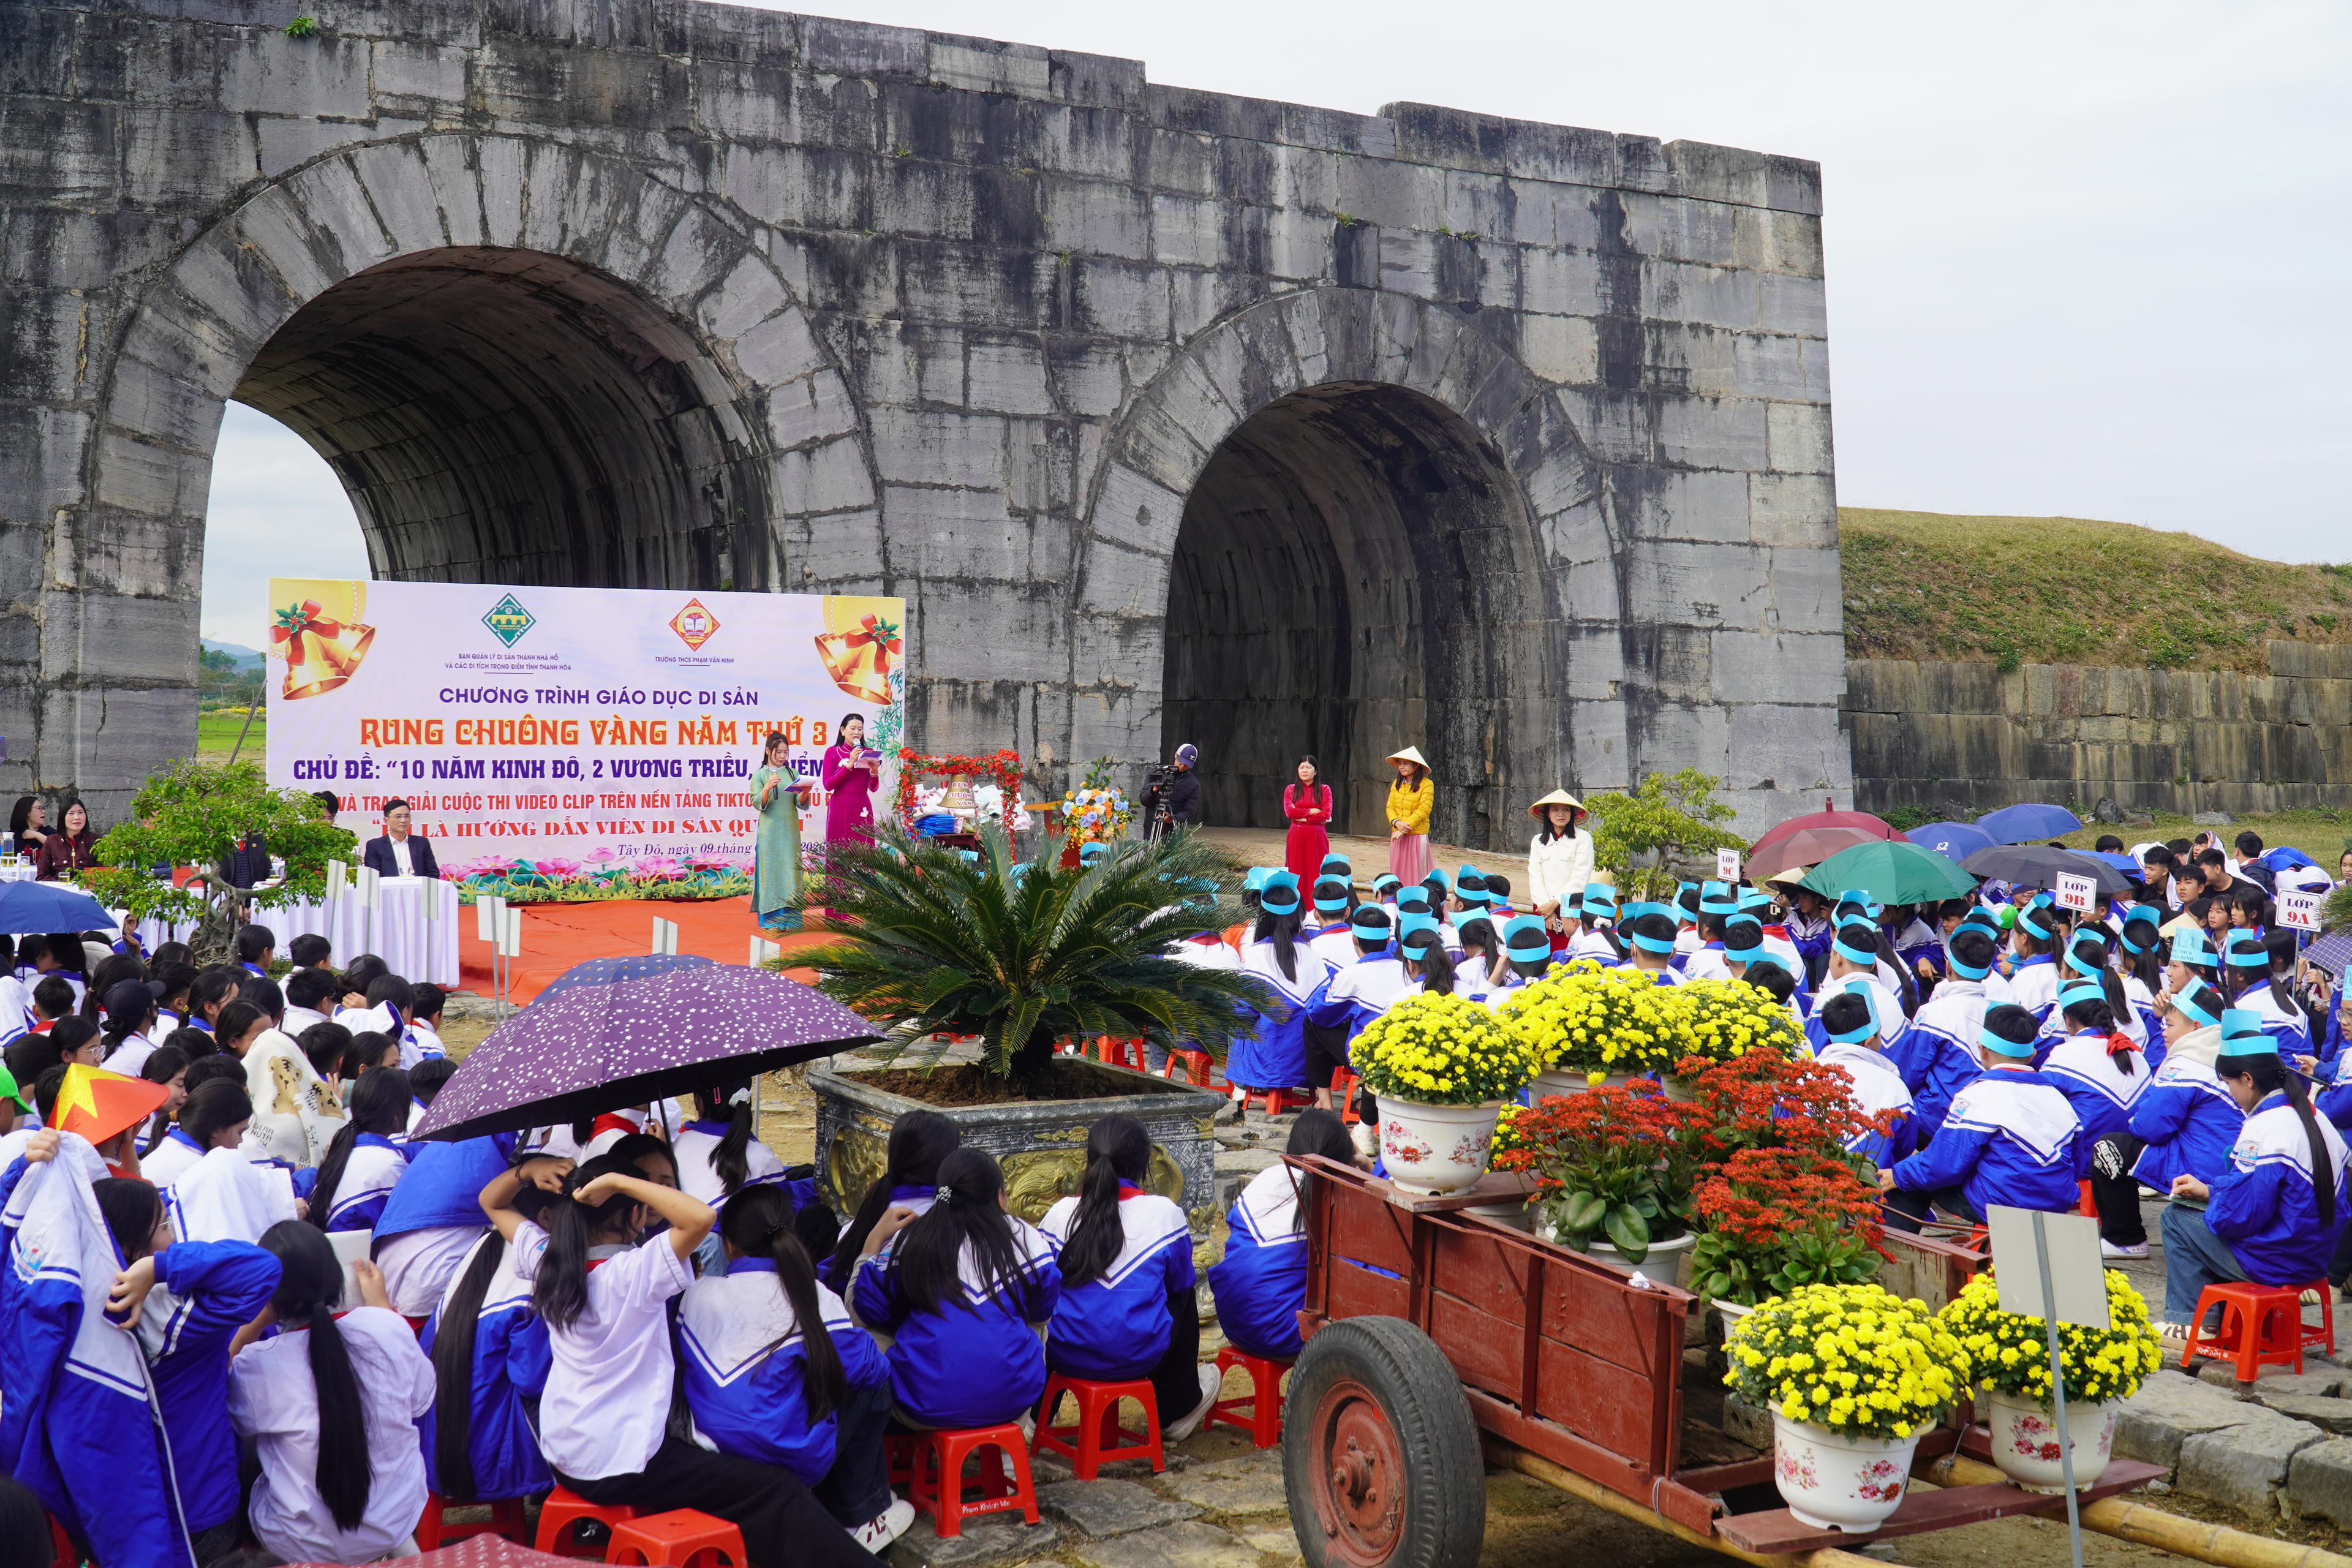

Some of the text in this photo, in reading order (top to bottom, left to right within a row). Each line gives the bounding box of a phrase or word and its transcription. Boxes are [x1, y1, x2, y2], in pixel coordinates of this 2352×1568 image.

[439, 685, 758, 709] CHƯƠNG TRÌNH GIÁO DỤC DI SẢN
[360, 718, 443, 747] RUNG
[456, 714, 579, 745] CHUÔNG
[589, 714, 667, 745] VÀNG
[677, 715, 737, 745] NĂM
[813, 722, 827, 745] 3
[293, 754, 337, 779] CHỦ
[345, 752, 380, 779] ĐỀ:
[432, 755, 484, 779] NĂM
[492, 760, 545, 778] KINH
[552, 755, 585, 782] ĐÔ,
[593, 760, 603, 778] 2
[611, 759, 683, 778] VƯƠNG
[688, 752, 752, 780] TRIỀU,
[339, 793, 356, 811] VÀ
[363, 795, 401, 812] TRA
[407, 790, 437, 811] GIẢI
[442, 792, 482, 813] CUỘC
[488, 794, 510, 810] THI
[515, 794, 557, 810] VIDEO
[563, 794, 595, 810] CLIP
[600, 791, 638, 809] TRÊN
[641, 789, 669, 808] NỀN
[674, 788, 711, 808] TẢNG
[421, 820, 450, 837] LÀ
[456, 819, 535, 837] HƯỚNG
[545, 815, 589, 835] DẪN
[595, 817, 646, 835] VIÊN
[652, 820, 676, 834] DI
[682, 816, 723, 834] SẢN
[617, 844, 640, 857] Tây
[644, 844, 663, 856] Đô,
[668, 843, 697, 856] ngày
[700, 843, 714, 853] 09
[717, 843, 752, 854] tháng
[1722, 855, 1735, 864] LỚP
[1723, 866, 1734, 876] 9C
[2065, 881, 2087, 892] LỚP
[2065, 893, 2085, 906] 9B
[2287, 898, 2313, 909] LỚP
[2287, 911, 2309, 924] 9A
